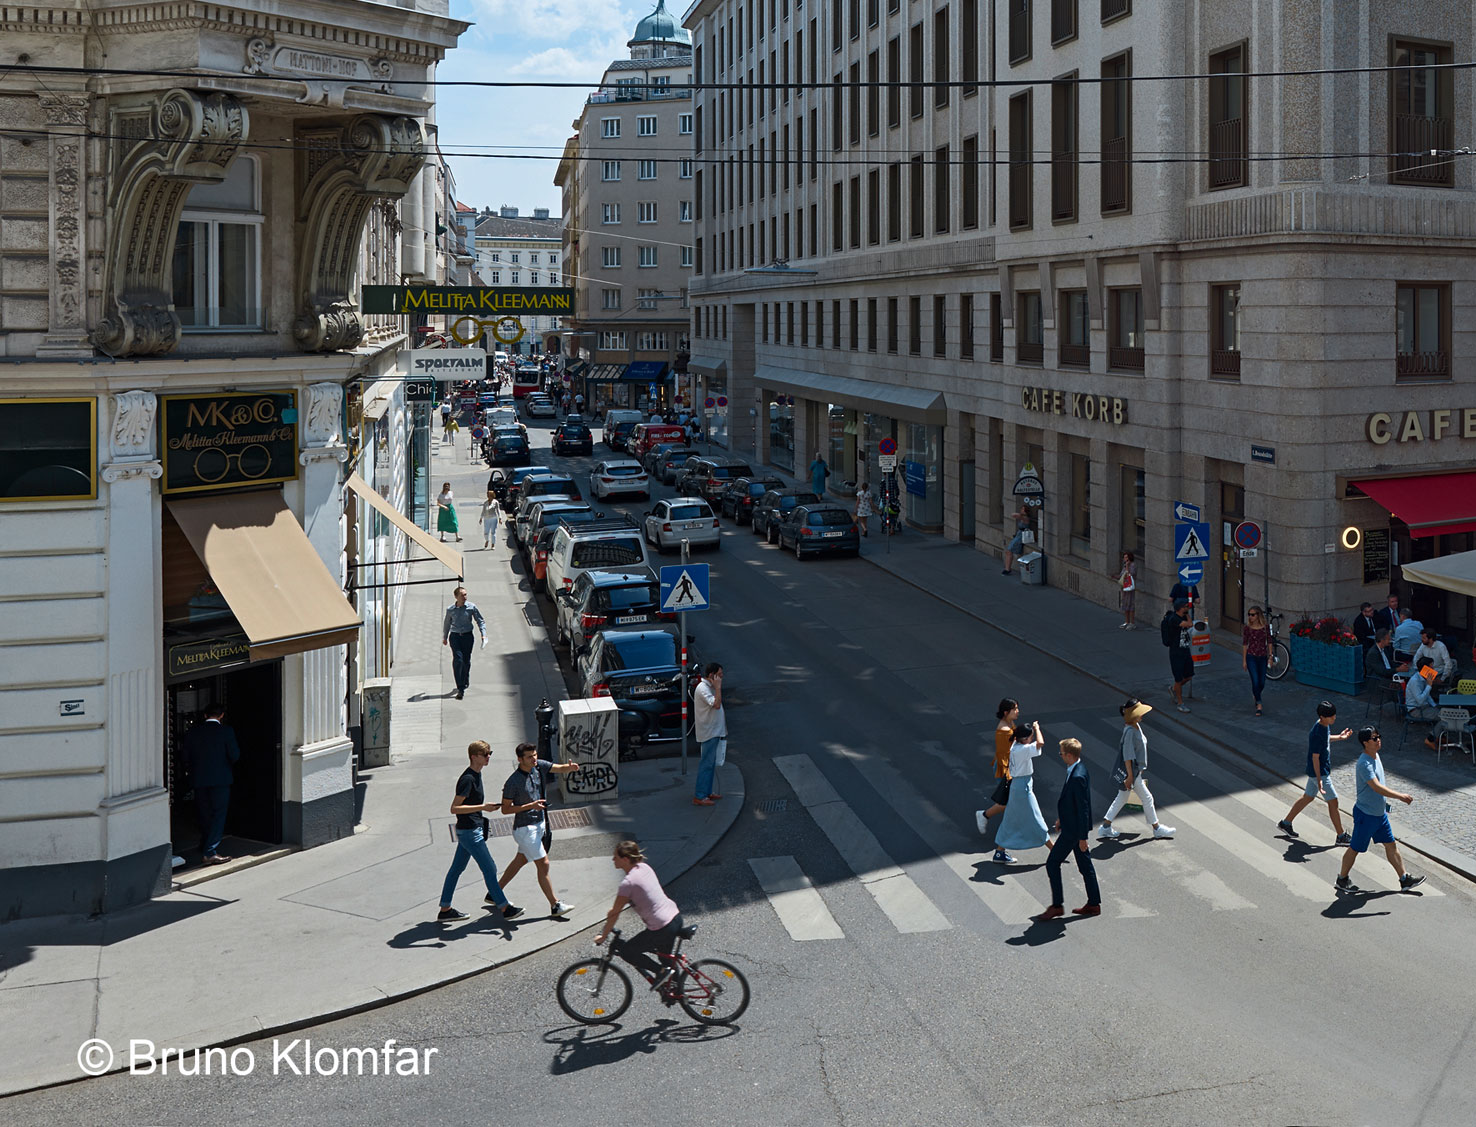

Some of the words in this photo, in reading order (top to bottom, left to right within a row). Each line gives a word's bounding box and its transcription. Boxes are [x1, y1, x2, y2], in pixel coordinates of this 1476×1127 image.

[405, 289, 477, 311] MELITTA
[480, 289, 570, 312] KLEEMANN
[414, 358, 483, 373] SPORTALM
[1022, 387, 1064, 415] CAFE
[1072, 392, 1125, 425] KORB
[210, 644, 250, 660] KLEEMAN
